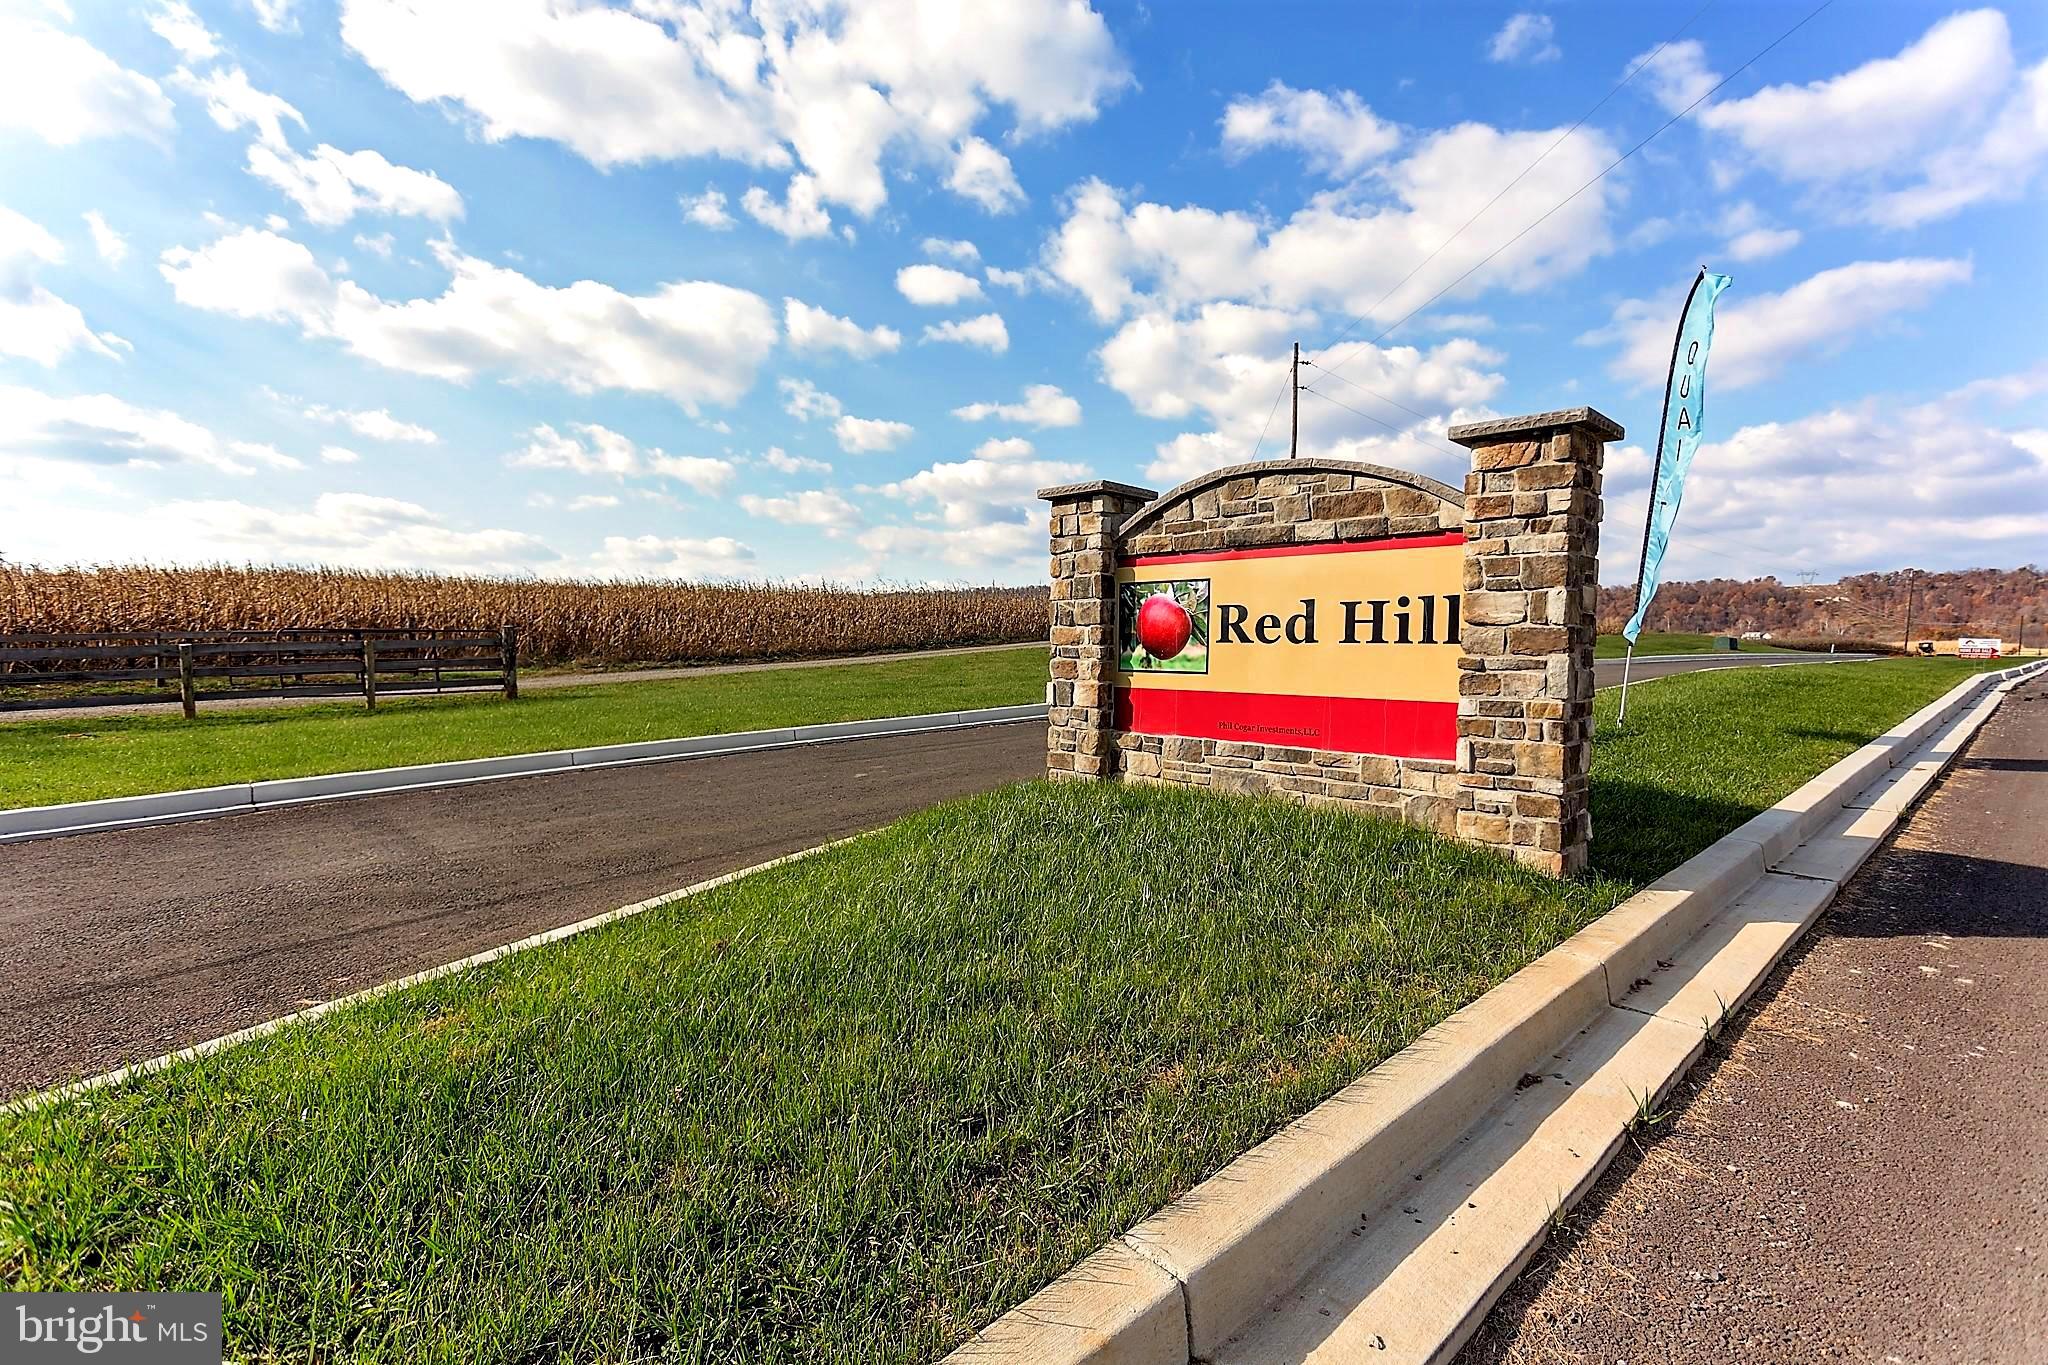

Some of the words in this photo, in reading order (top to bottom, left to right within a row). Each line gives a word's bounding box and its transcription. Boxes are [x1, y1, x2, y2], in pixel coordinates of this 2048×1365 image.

[1215, 598, 1319, 644] Red
[1339, 595, 1462, 645] Hill
[1218, 720, 1233, 730] Phil
